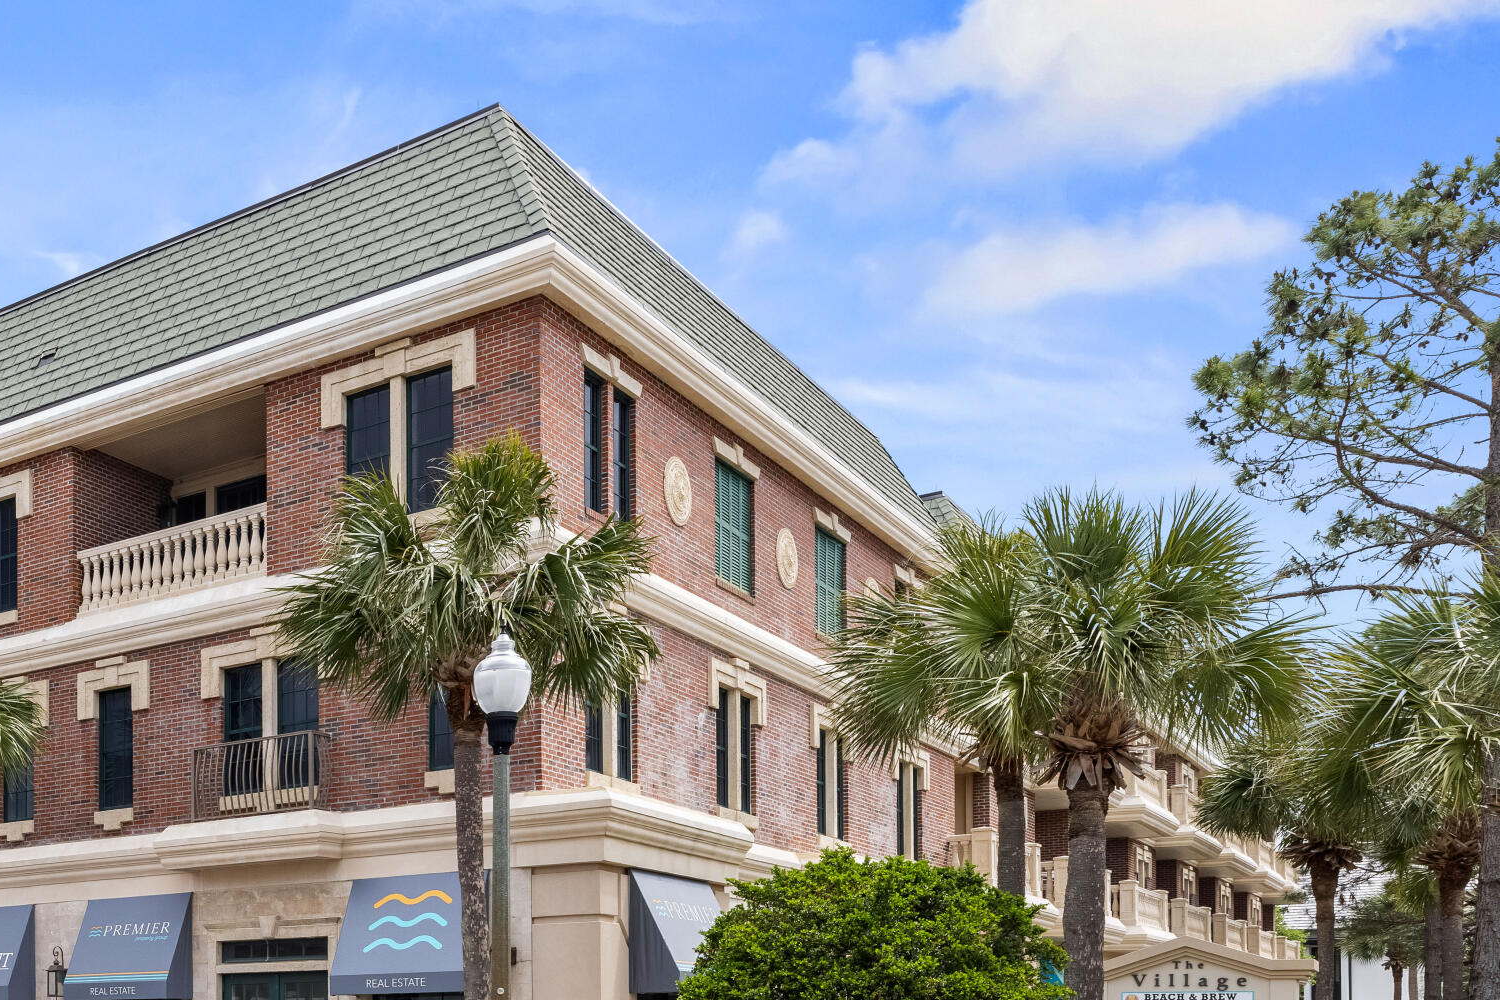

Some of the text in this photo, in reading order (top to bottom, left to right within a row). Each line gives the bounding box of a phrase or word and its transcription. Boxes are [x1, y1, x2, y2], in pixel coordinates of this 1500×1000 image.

[103, 921, 170, 937] PREMIER
[1172, 961, 1204, 970] The
[365, 977, 427, 988] REAL ESTATE
[1132, 974, 1248, 992] Village
[90, 986, 137, 996] REAL ESTATE
[1144, 993, 1238, 1000] BEACH & BREW
